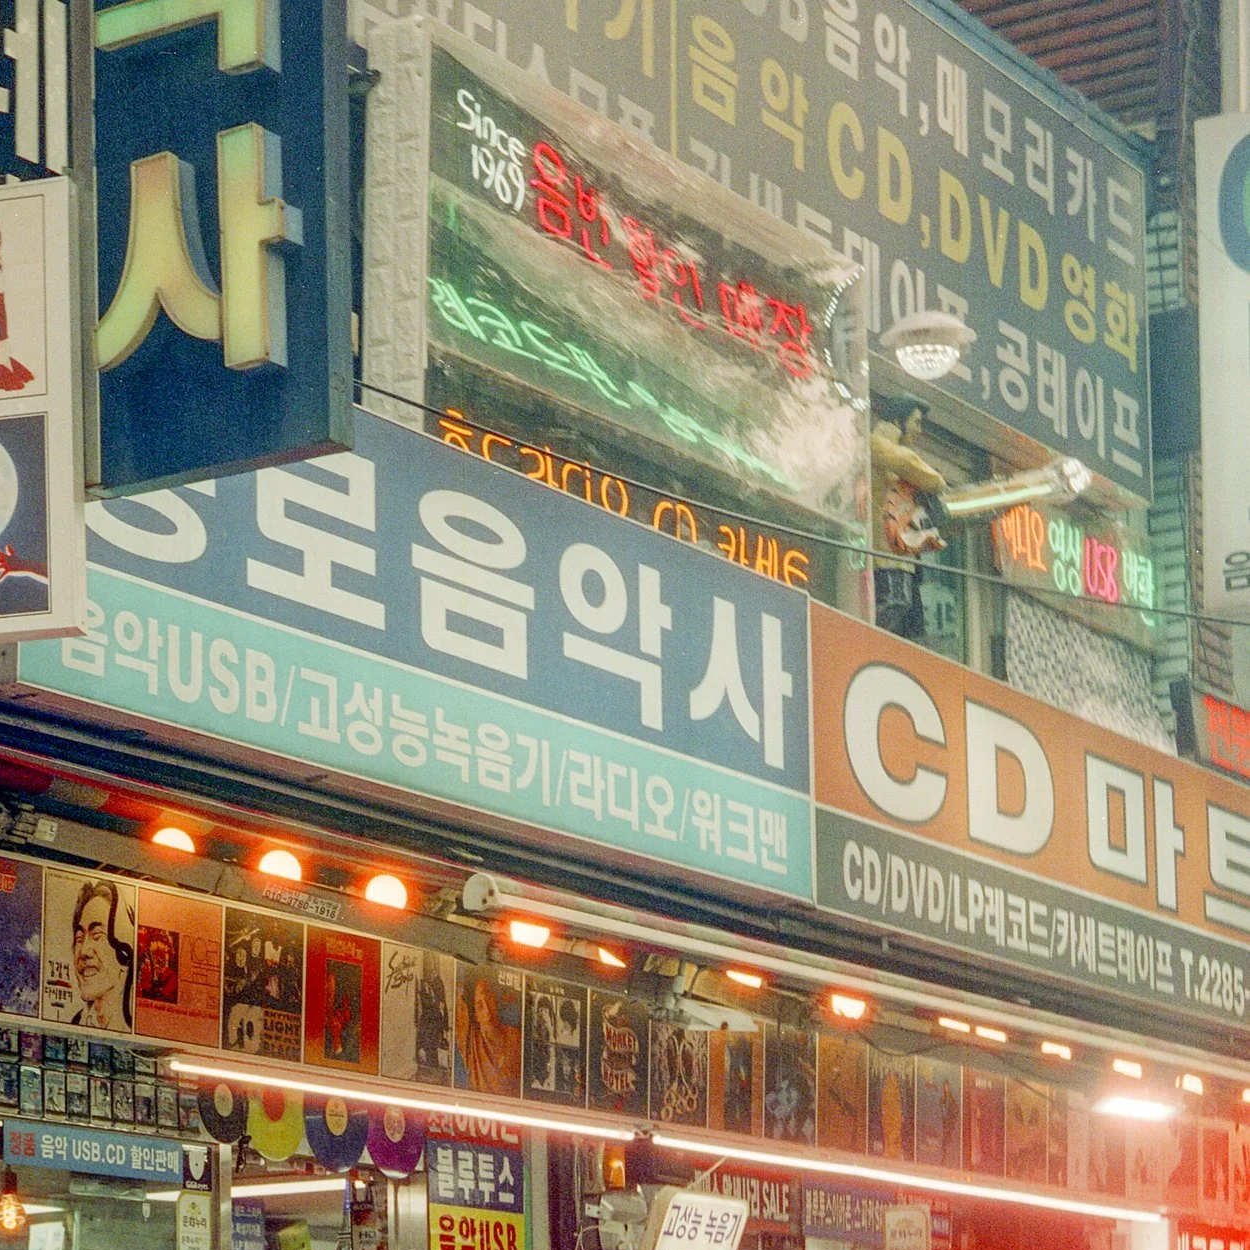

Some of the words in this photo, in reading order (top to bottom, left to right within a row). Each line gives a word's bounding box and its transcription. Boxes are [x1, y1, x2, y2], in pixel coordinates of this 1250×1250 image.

[456, 88, 526, 163] Since
[470, 143, 525, 213] 1969
[529, 140, 614, 271] 음반
[1085, 536, 1119, 604] USB
[843, 660, 1056, 858] CD
[842, 839, 1175, 996] CD/DVD/LP레코드/카세트테이프
[41, 1133, 69, 1161] 음악
[72, 1136, 127, 1167] USB.CD
[130, 1143, 180, 1175] 할인판매
[435, 1145, 516, 1206] 블루투스
[662, 1204, 703, 1240] 고성능
[704, 1209, 743, 1248] 녹음기
[762, 1182, 790, 1223] SALE
